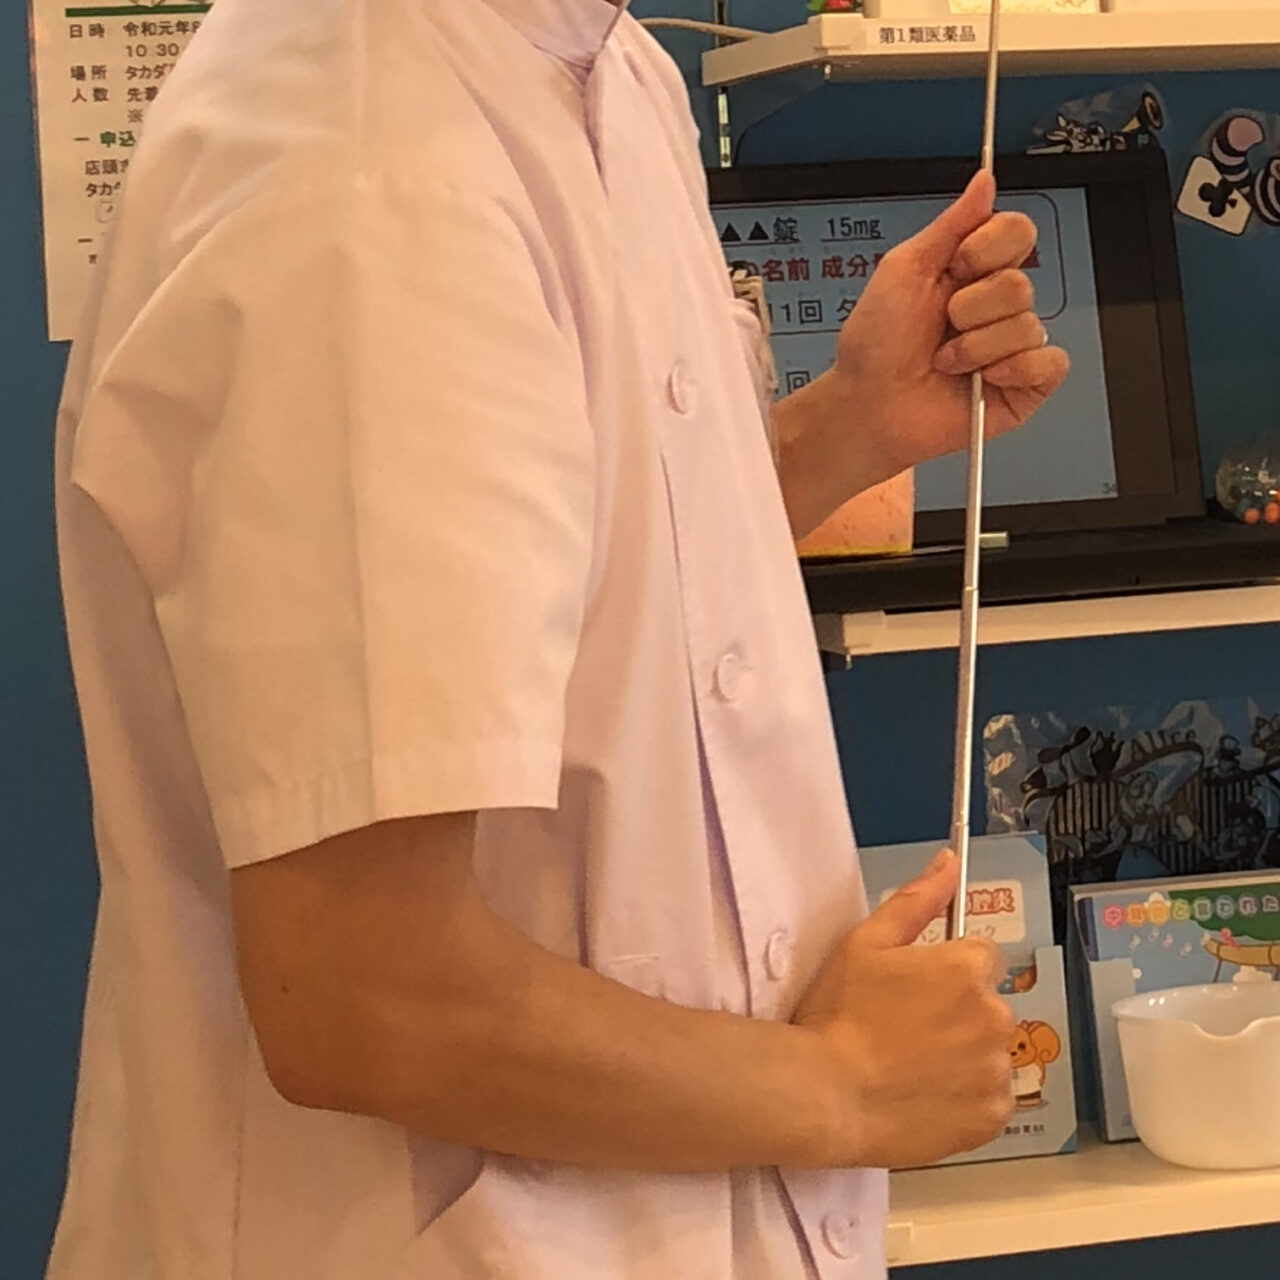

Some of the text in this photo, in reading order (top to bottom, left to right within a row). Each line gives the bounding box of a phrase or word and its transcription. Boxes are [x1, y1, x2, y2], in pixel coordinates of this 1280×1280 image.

[879, 25, 977, 45] 第1類医薬品
[124, 62, 174, 82] タカダ
[825, 215, 884, 240] 15mg
